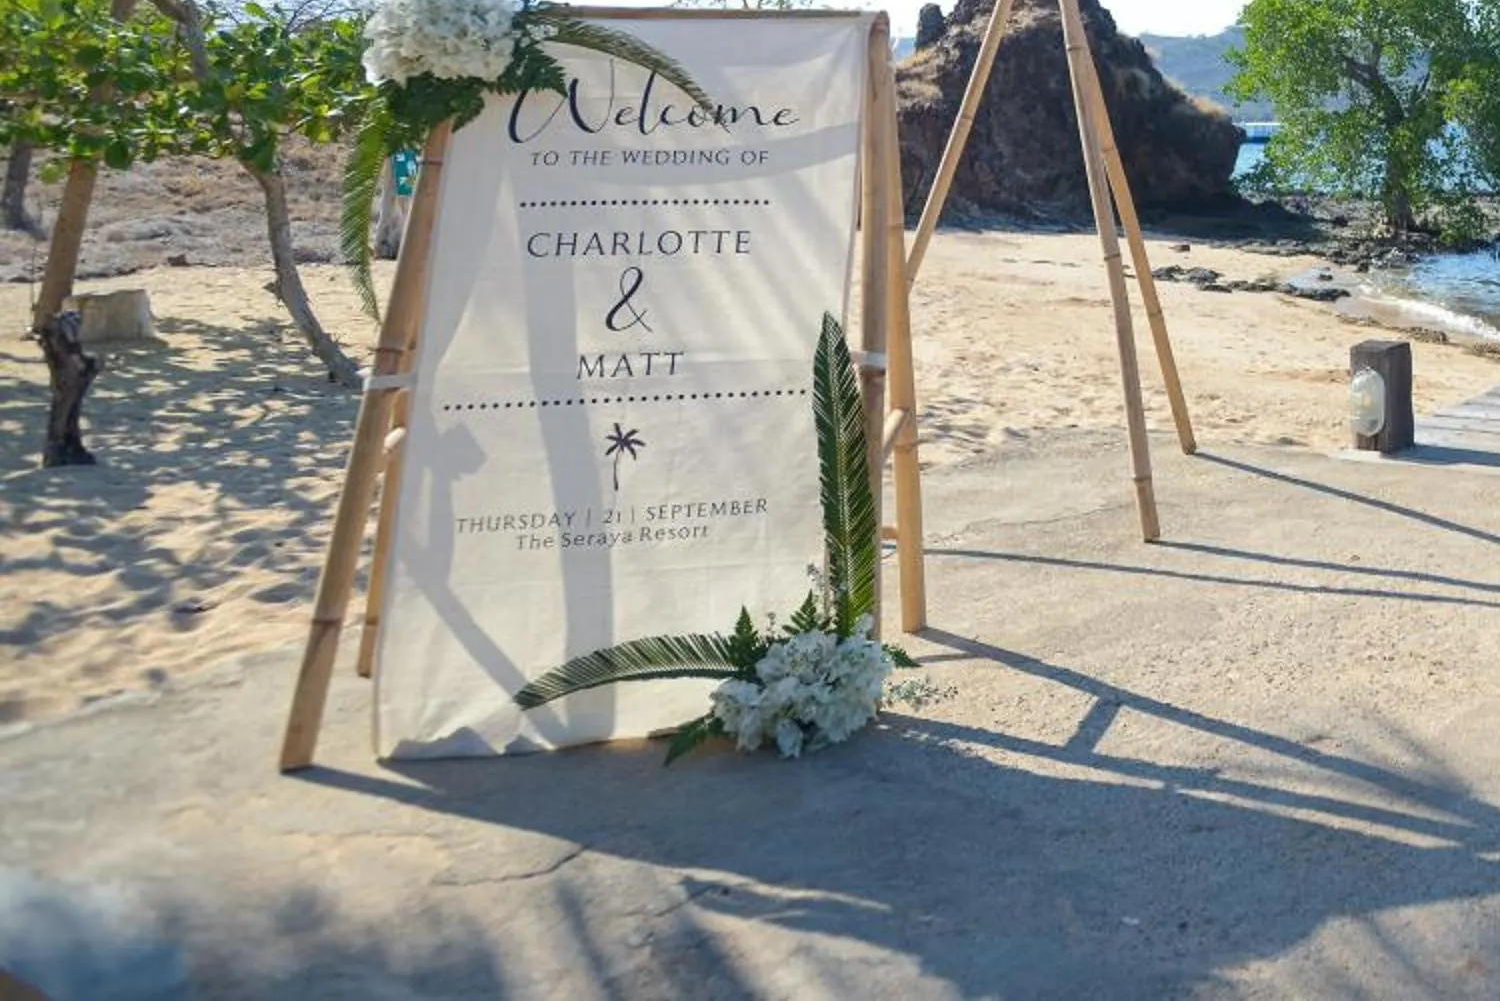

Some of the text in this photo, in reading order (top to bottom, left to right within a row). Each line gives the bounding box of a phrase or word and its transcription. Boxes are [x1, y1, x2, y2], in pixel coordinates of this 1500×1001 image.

[508, 57, 799, 143] Welcome
[531, 149, 770, 167] TO THE WEDDING OF
[526, 230, 752, 258] CHARLOTTE
[604, 266, 654, 333] &
[576, 351, 685, 380] MATT
[455, 511, 576, 534] THURSDAY
[645, 498, 769, 521] SEPTEMBER
[516, 524, 710, 551] The Seraya Resort
